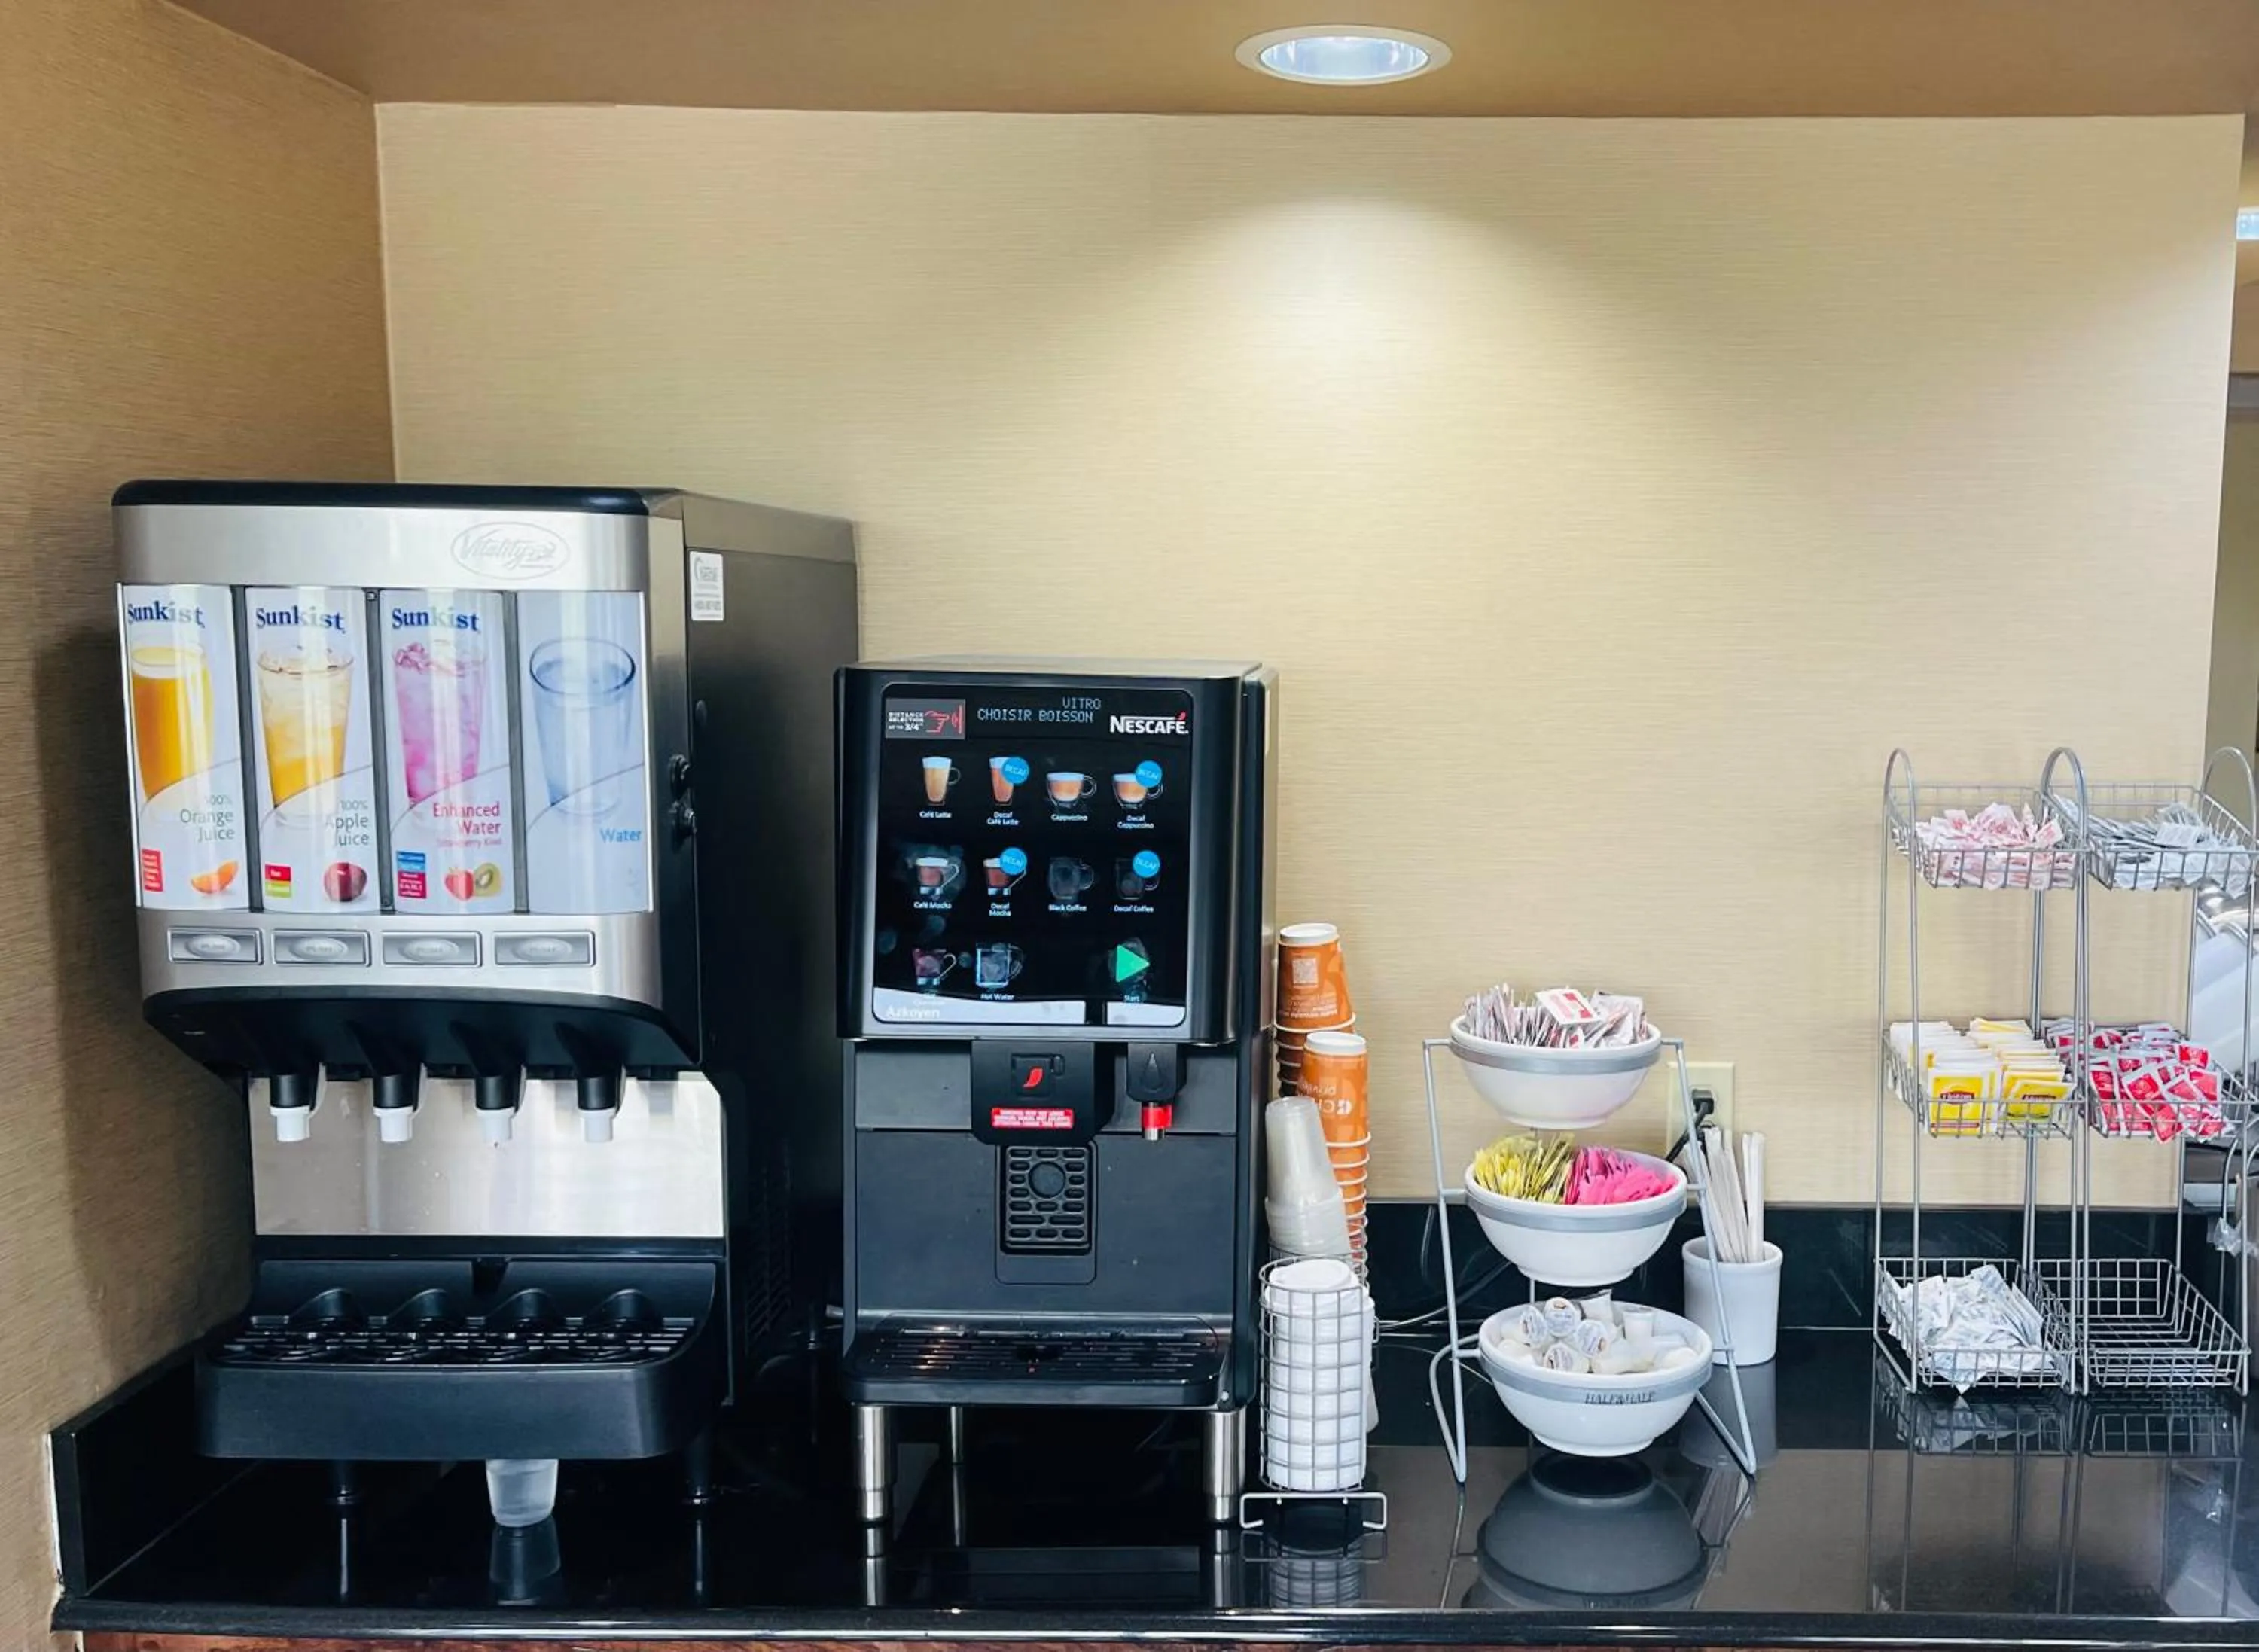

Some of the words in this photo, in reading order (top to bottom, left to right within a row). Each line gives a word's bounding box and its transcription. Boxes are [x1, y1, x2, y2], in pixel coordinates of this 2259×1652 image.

[127, 600, 205, 628] Sunkist
[256, 605, 346, 633] Sunkist
[392, 605, 479, 631] Sunkist
[1062, 697, 1102, 710] VITRO
[977, 709, 1032, 721] CHOISIR
[1038, 710, 1093, 723] BOISSON
[1110, 712, 1189, 734] NESCAFÉ
[180, 809, 233, 826] Orange
[433, 801, 501, 818] Enhanced
[326, 814, 369, 833] Apple
[459, 819, 501, 835] Water
[198, 827, 235, 842] Juice
[600, 829, 642, 843] Water
